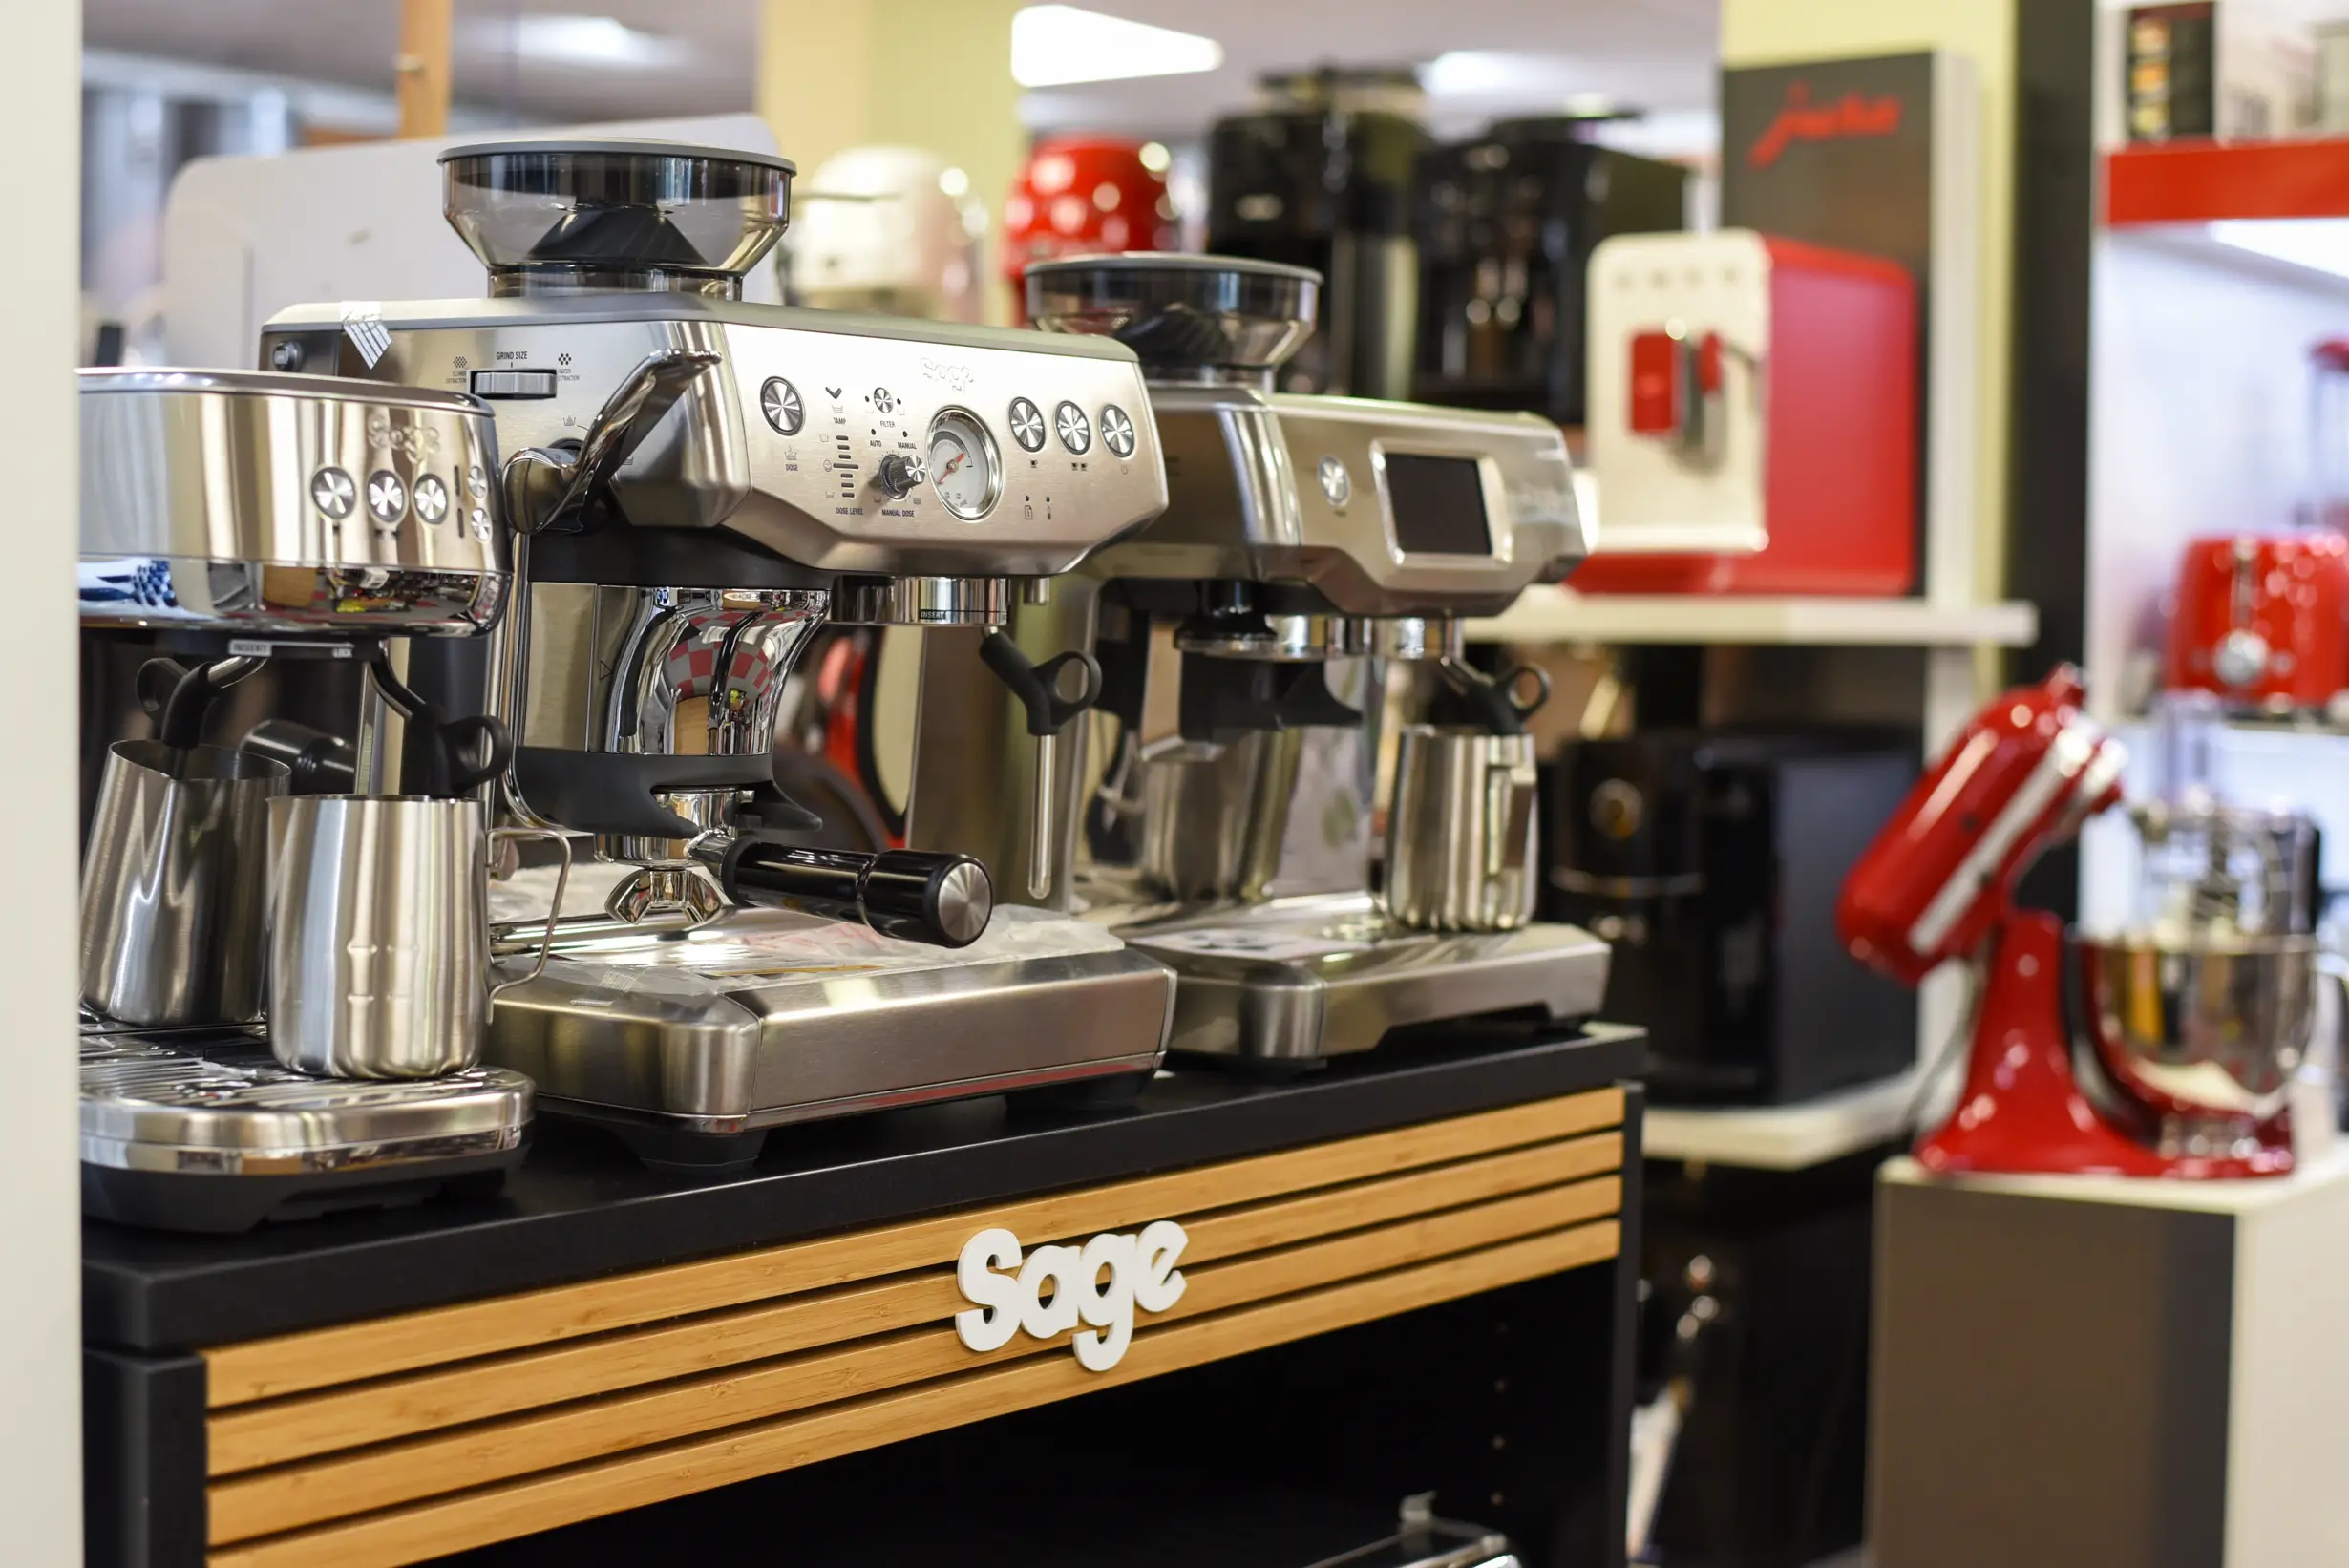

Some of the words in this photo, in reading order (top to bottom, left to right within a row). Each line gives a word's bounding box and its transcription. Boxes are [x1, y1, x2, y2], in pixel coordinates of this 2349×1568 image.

[496, 351, 515, 361] GRIND
[515, 350, 528, 360] SIZE
[898, 441, 917, 450] MANUAL
[785, 463, 799, 472] DOSE
[881, 509, 901, 518] MANUAL
[955, 1220, 1189, 1372] Sage
